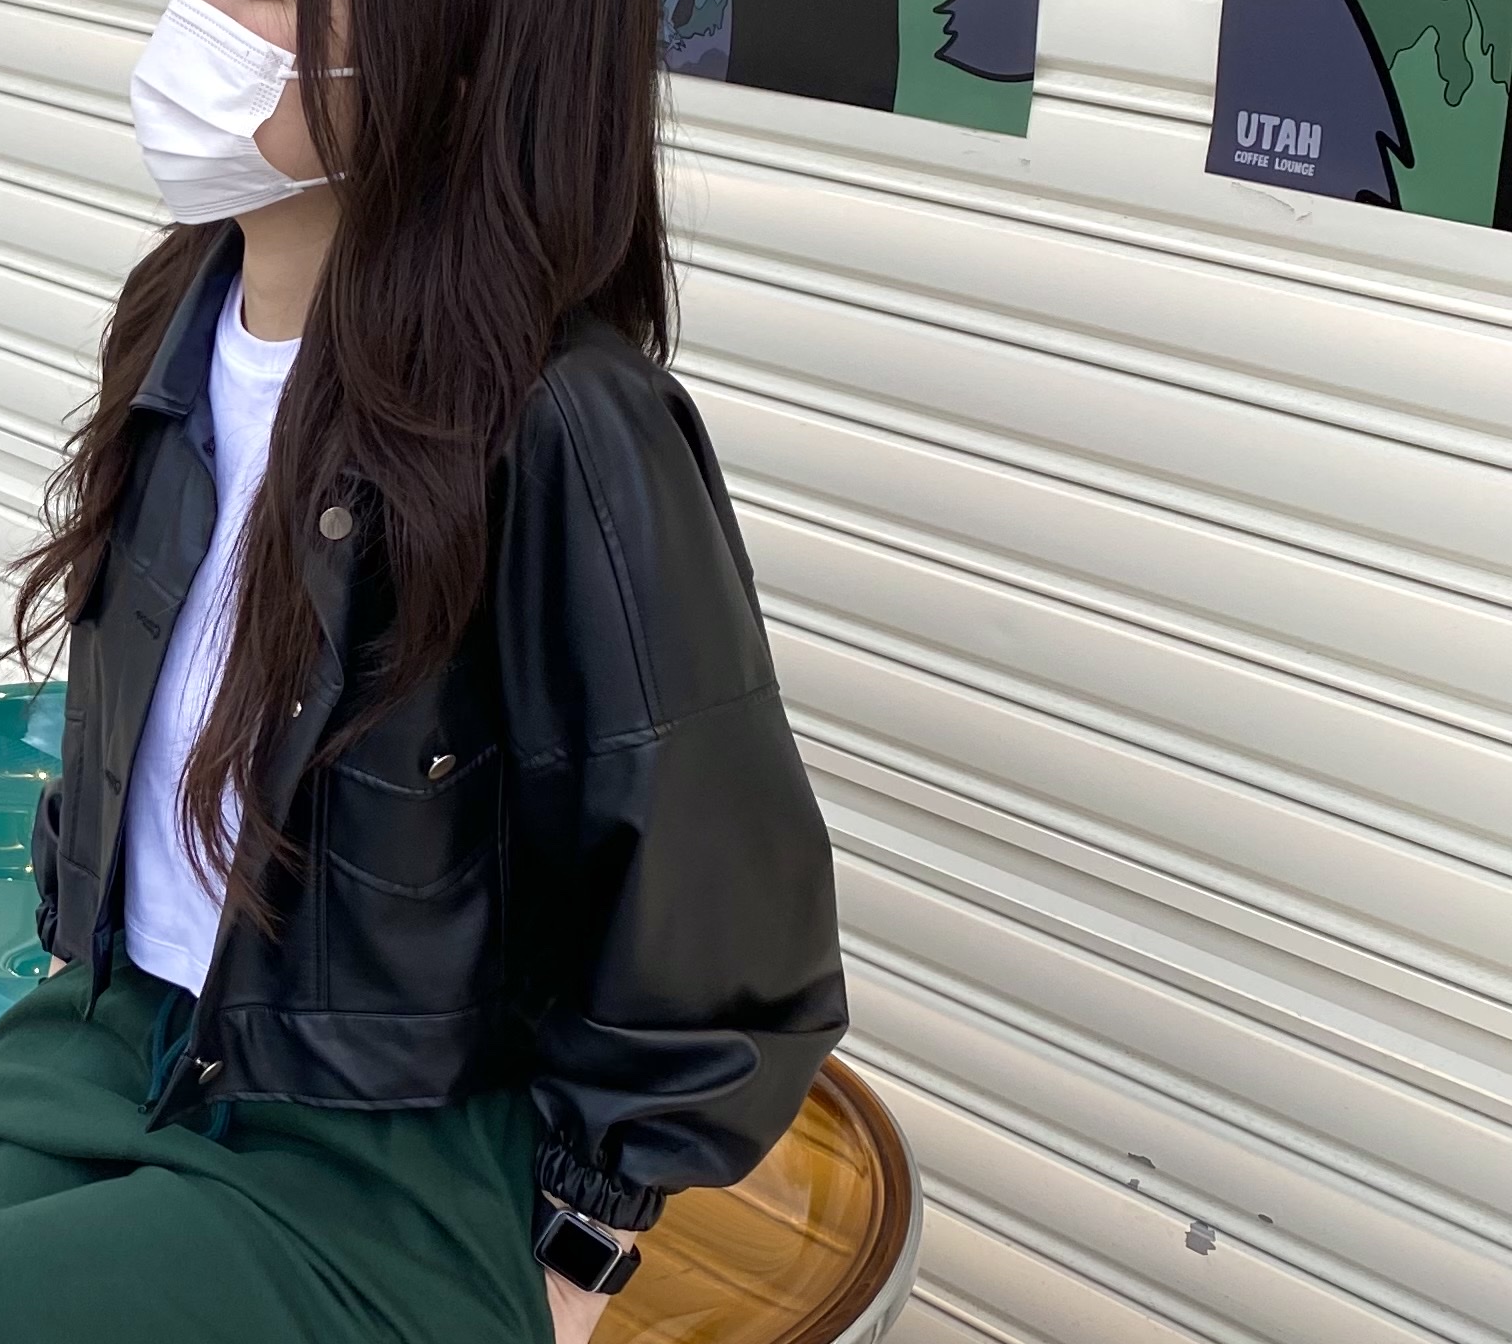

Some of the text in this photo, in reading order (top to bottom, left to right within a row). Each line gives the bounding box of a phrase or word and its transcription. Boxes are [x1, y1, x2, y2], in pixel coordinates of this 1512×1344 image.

[1236, 110, 1322, 159] UTAH
[1234, 150, 1316, 177] COFFEE LOUNGE
